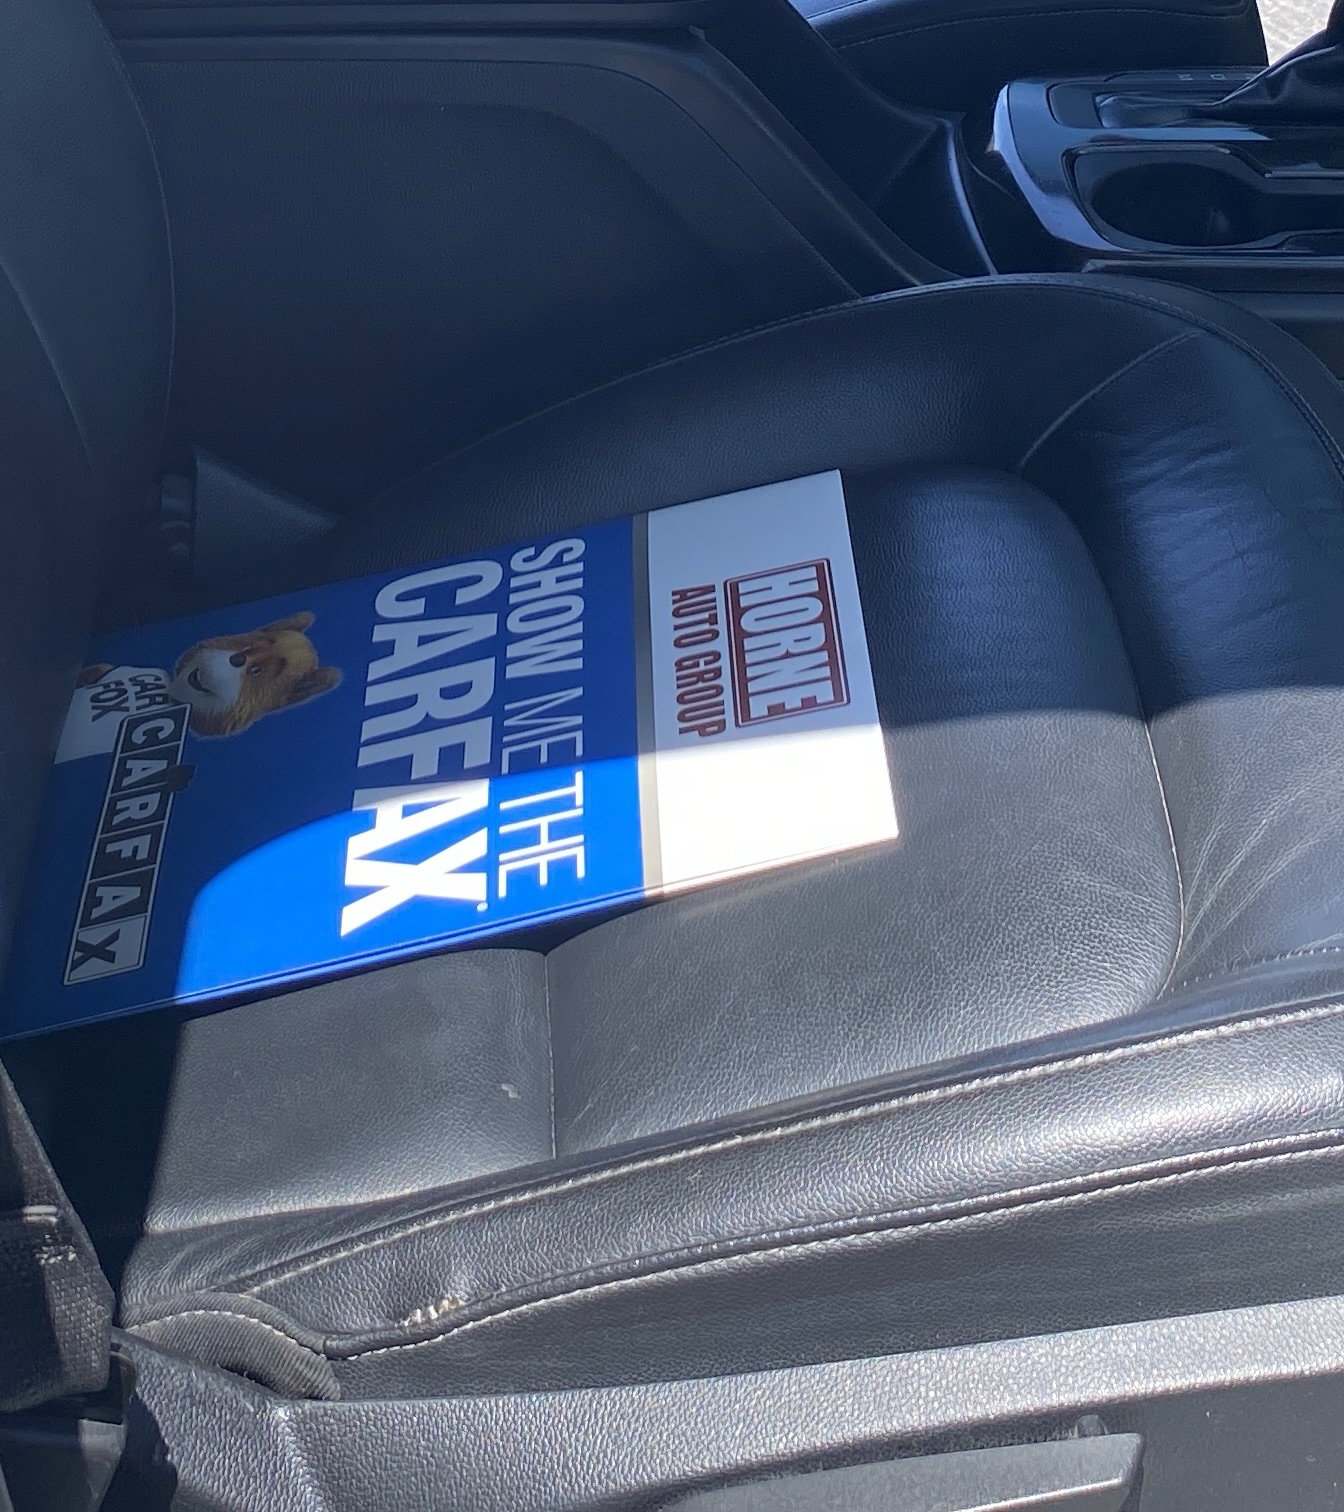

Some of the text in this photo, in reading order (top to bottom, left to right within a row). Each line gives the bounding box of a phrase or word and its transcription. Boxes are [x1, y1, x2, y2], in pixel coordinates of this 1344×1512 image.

[86, 679, 130, 724] FOX
[128, 673, 170, 711] CAR
[498, 537, 586, 899] SHOW ME THE
[671, 583, 727, 738] AUTO GROUP
[737, 564, 836, 720] HORNE
[339, 559, 504, 938] CARFAX
[69, 717, 176, 974] CARFAX
